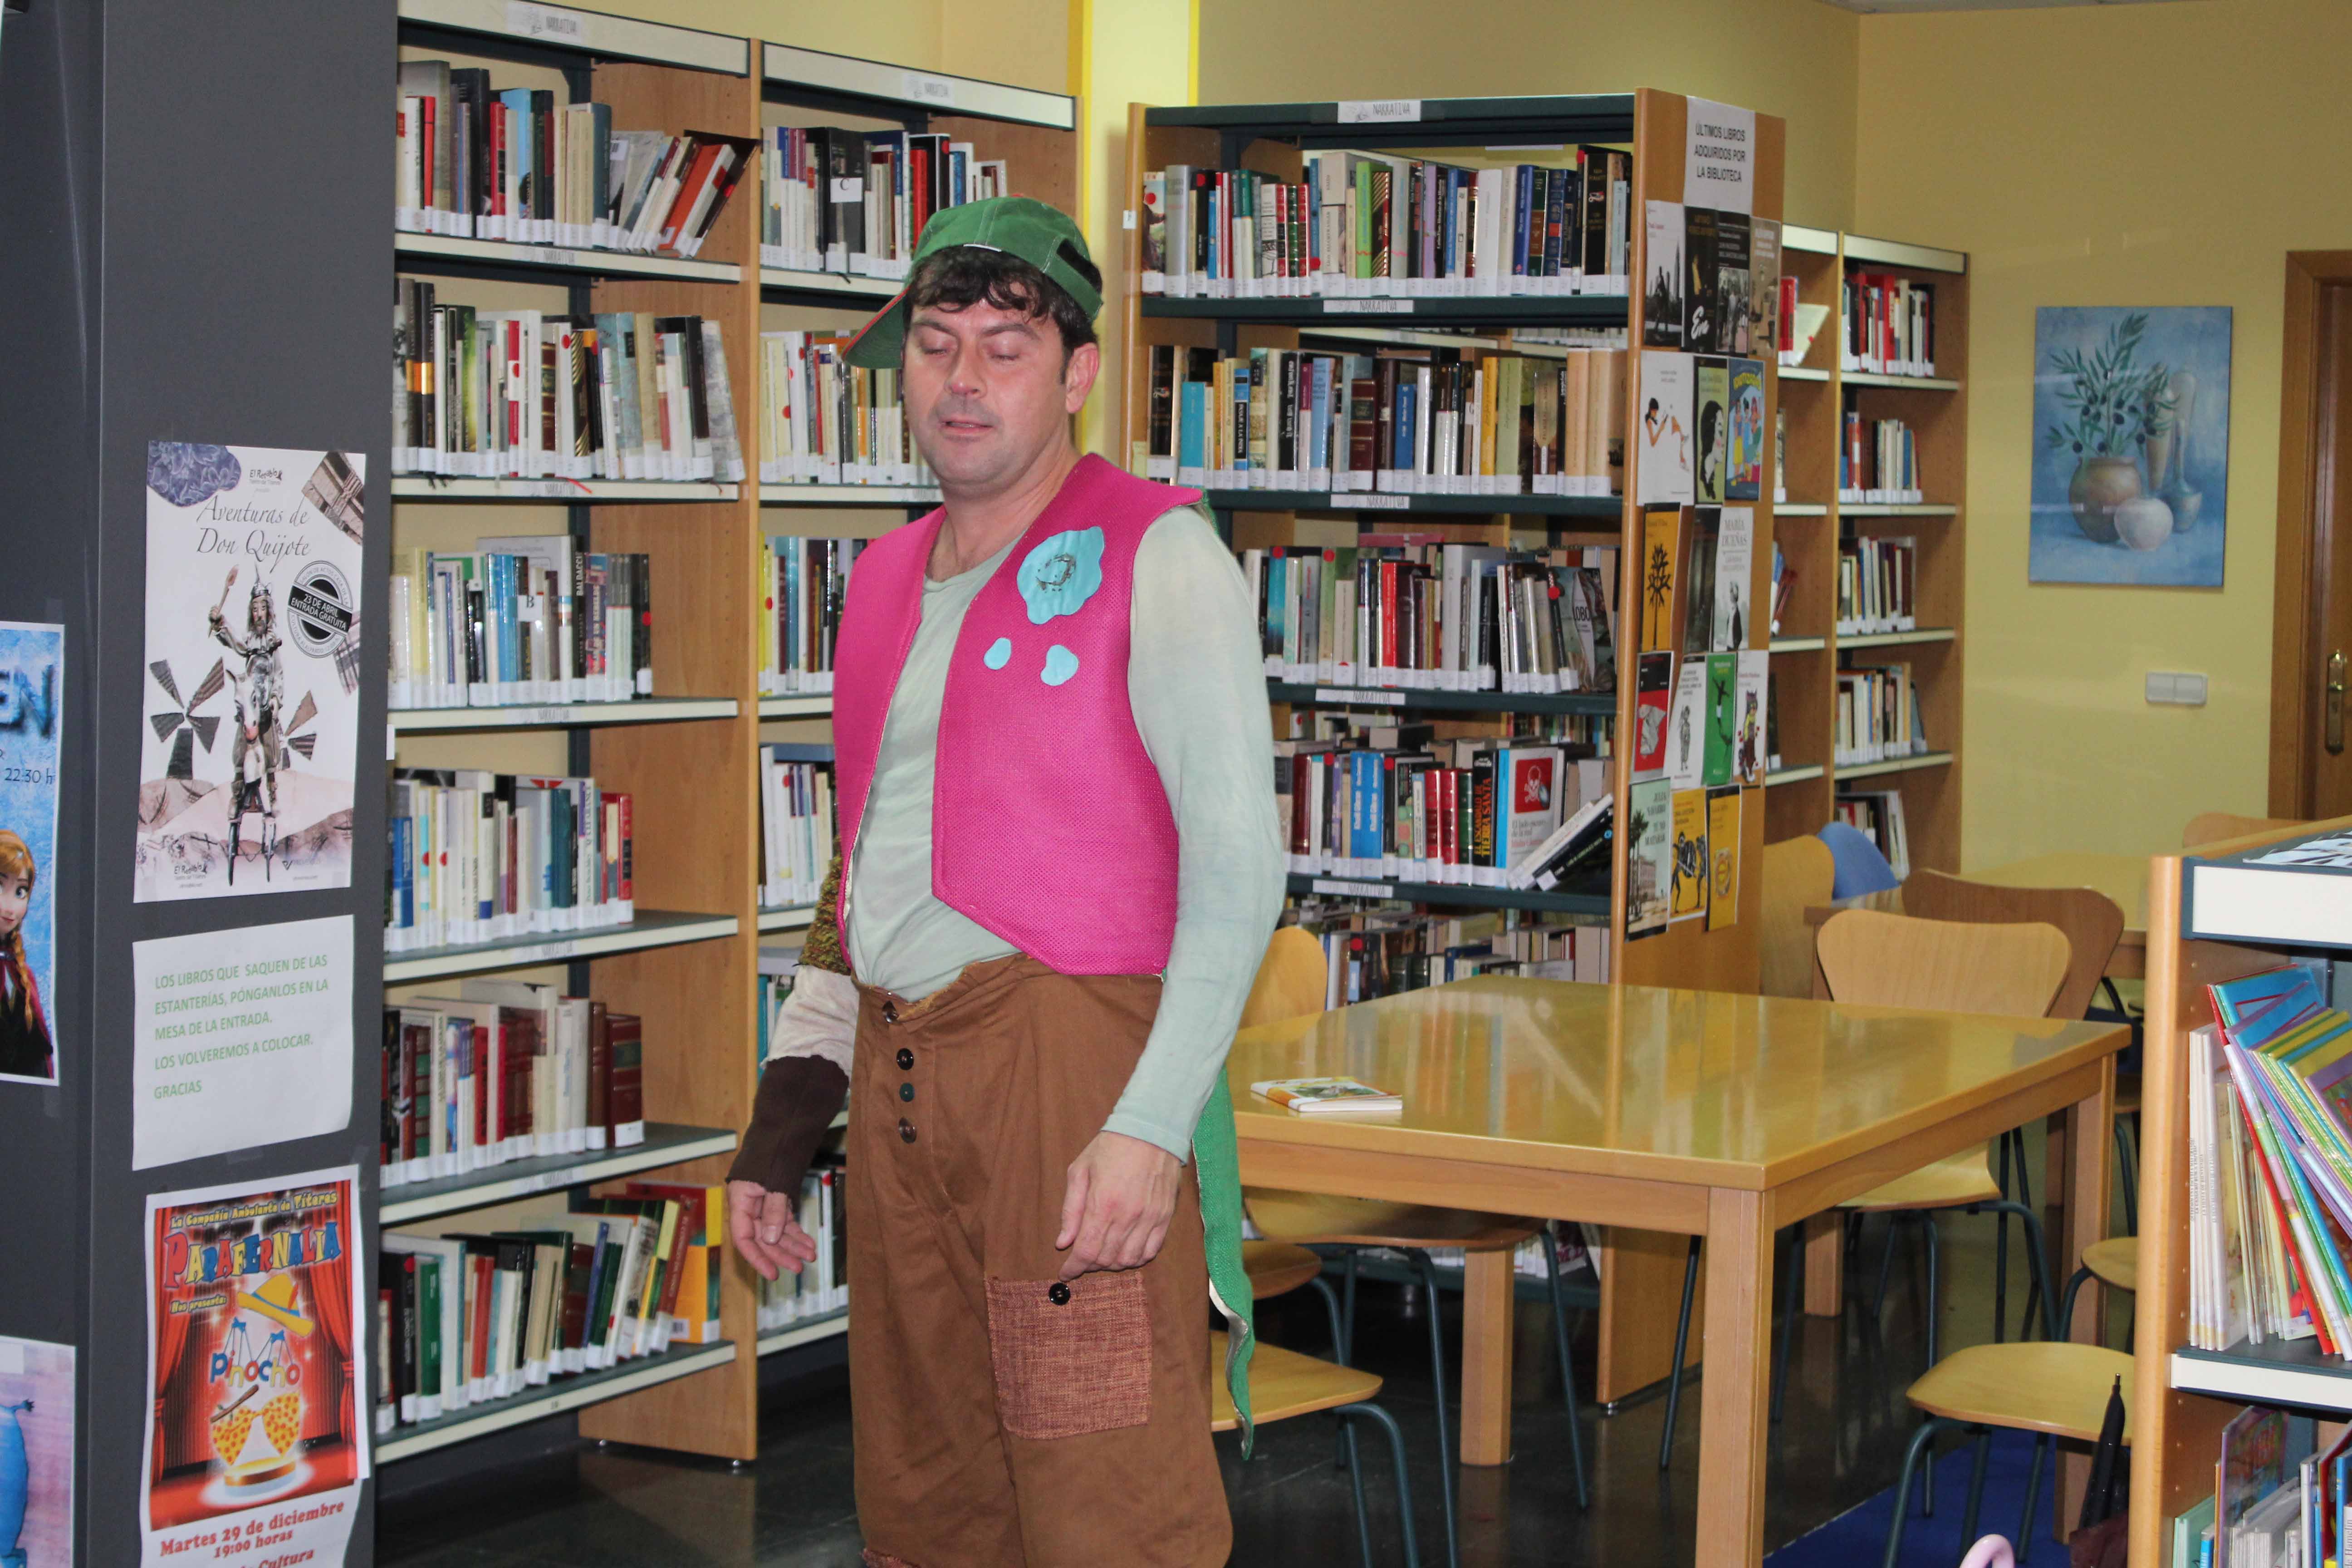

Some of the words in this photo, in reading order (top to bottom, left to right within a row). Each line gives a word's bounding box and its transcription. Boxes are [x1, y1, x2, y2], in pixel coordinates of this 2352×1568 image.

[1694, 144, 1731, 160] ADQUIRIDOS
[1733, 149, 1745, 162] POR
[1697, 166, 1705, 177] LA
[1706, 167, 1742, 182] BIBLIOTECA
[196, 495, 283, 524] Aventuras
[289, 495, 309, 526] de
[197, 528, 237, 554] Don
[245, 529, 310, 573] Quijote
[291, 598, 318, 617] ENTRADA
[319, 611, 347, 630] GRATUITA
[303, 594, 312, 604] 23
[312, 598, 321, 609] DE
[322, 603, 338, 617] ABRIL
[527, 595, 534, 608] B
[5, 768, 41, 784] 22:30
[1482, 777, 1492, 815] SANTA
[156, 975, 174, 989] LOS
[178, 969, 213, 985] LIBROS
[216, 965, 239, 980] QUE
[245, 960, 289, 977] SAQUEN
[293, 957, 306, 970] DE
[309, 954, 327, 968] LAS
[155, 991, 227, 1015] ESTANTERÍAS,
[230, 983, 296, 1002] PÓNGANLOS
[299, 981, 313, 994] EN
[316, 979, 328, 991] LA
[155, 1025, 186, 1040] MESA
[189, 1022, 202, 1035] DE
[206, 1019, 218, 1033] LA
[220, 1011, 272, 1030] ENTRADA.
[155, 1055, 175, 1070] LOS
[178, 1043, 250, 1066] VOLVEREMOS
[252, 1042, 259, 1053] A
[262, 1034, 314, 1053] COLOCAR.
[154, 1080, 202, 1099] GRACIAS
[171, 1217, 182, 1229] La
[186, 1209, 229, 1226] Compañía
[232, 1203, 278, 1220] Ambulante
[280, 1200, 290, 1211] de
[294, 1191, 337, 1209] Títeres
[164, 1221, 341, 1288] PARAFERNALIA
[171, 1301, 187, 1313] Nos
[160, 1533, 216, 1556] Martes
[222, 1526, 240, 1543] 29
[246, 1519, 263, 1535] de
[269, 1501, 344, 1530] diciembre
[214, 1542, 250, 1558] 19:00
[255, 1529, 293, 1549] horas
[258, 1550, 314, 1568] Cultura
